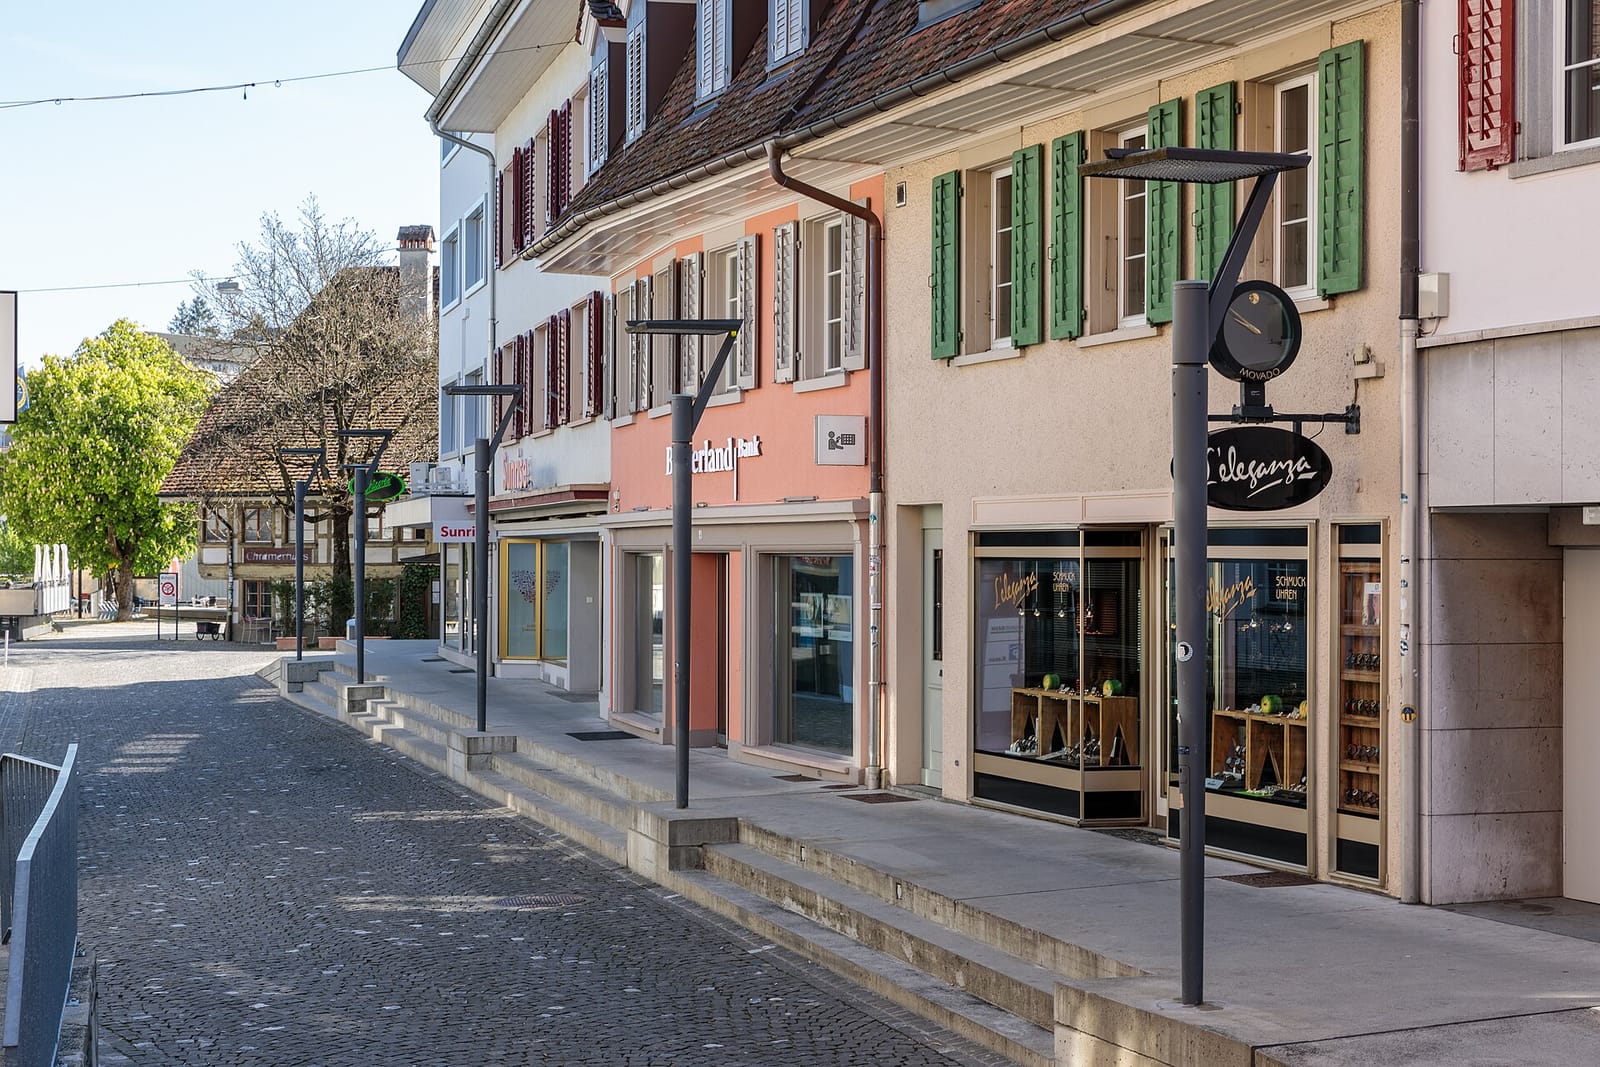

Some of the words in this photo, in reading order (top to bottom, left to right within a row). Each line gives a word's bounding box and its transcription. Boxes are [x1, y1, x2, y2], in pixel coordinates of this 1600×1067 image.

[1239, 367, 1281, 380] MOVADO
[665, 437, 734, 475] Berland
[737, 435, 761, 458] Bank
[440, 525, 491, 537] Sunri
[1275, 575, 1306, 587] SCHMUCK
[1275, 588, 1298, 600] UHREN
